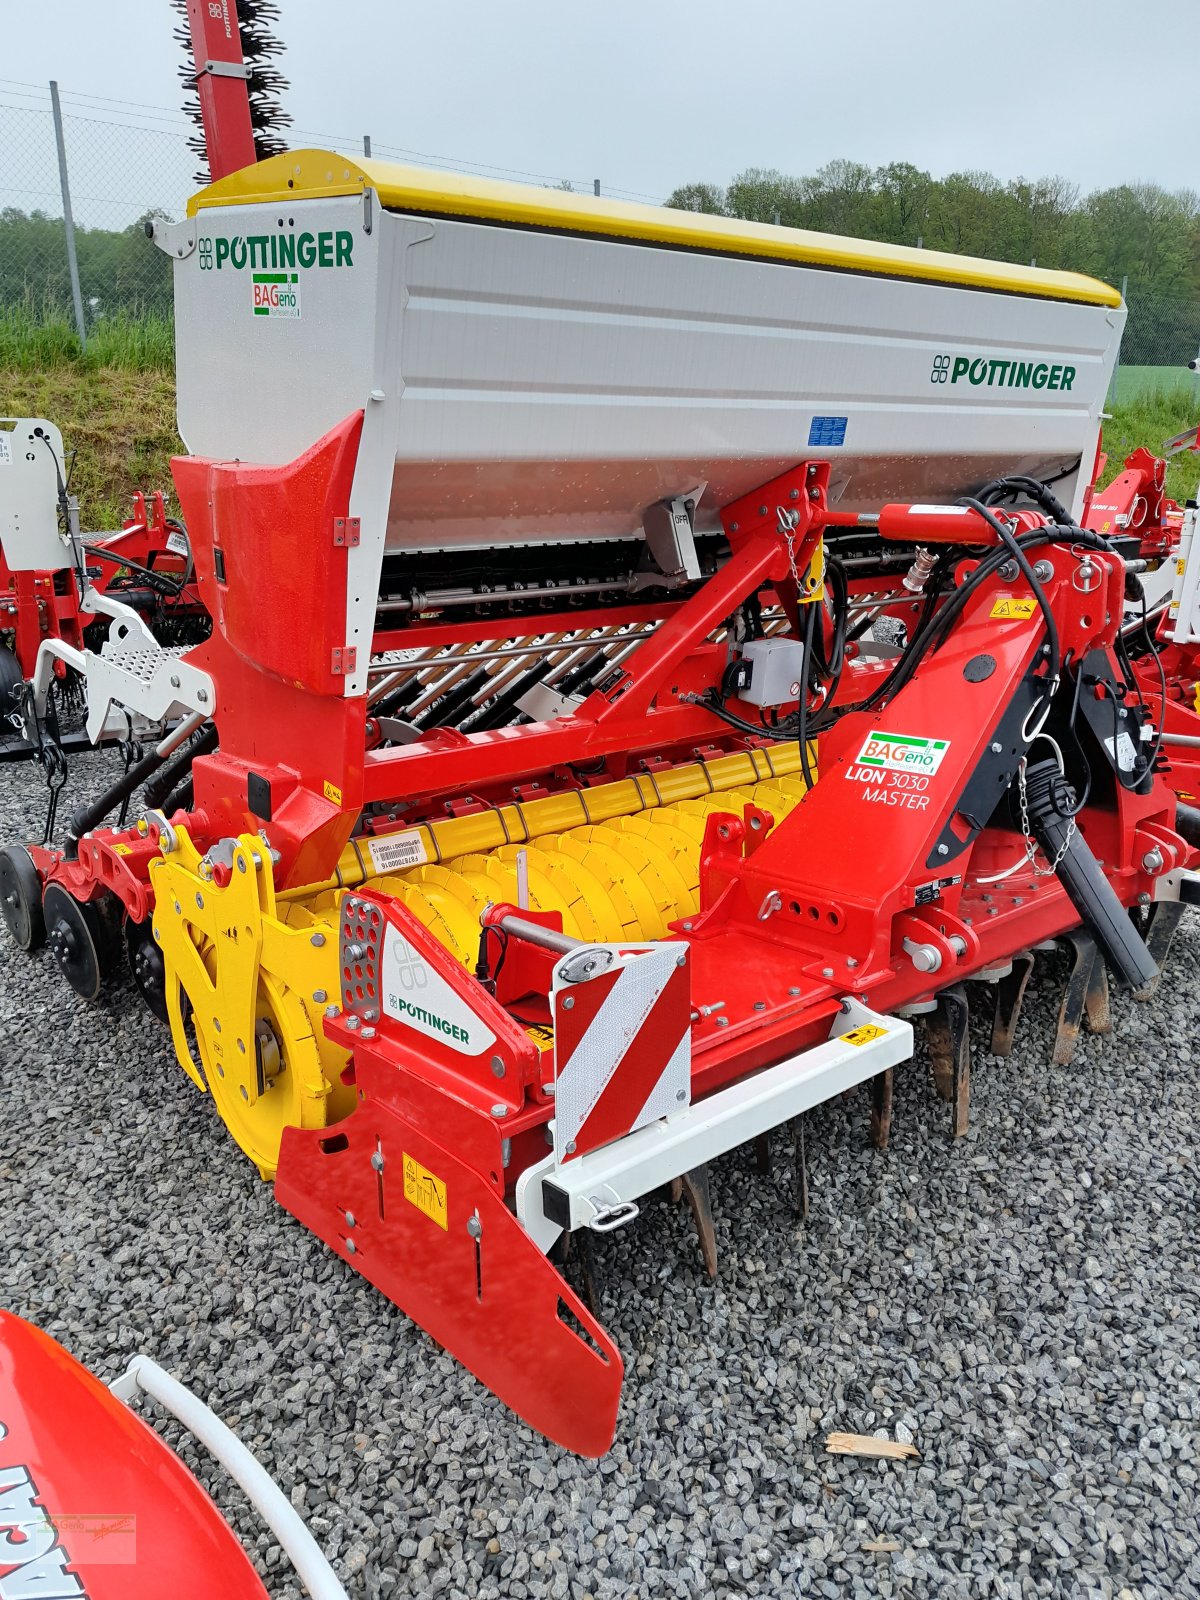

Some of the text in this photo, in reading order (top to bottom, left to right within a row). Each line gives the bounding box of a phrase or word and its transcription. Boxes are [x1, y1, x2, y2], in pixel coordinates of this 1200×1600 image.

[215, 230, 354, 270] PÖTTINGER
[254, 284, 297, 307] BAGeno
[951, 356, 1076, 391] PÖTTINGER
[864, 741, 934, 765] BAGeno
[845, 766, 930, 791] LION 3030
[862, 787, 930, 811] MASTER
[398, 998, 470, 1045] PÖTTINGER
